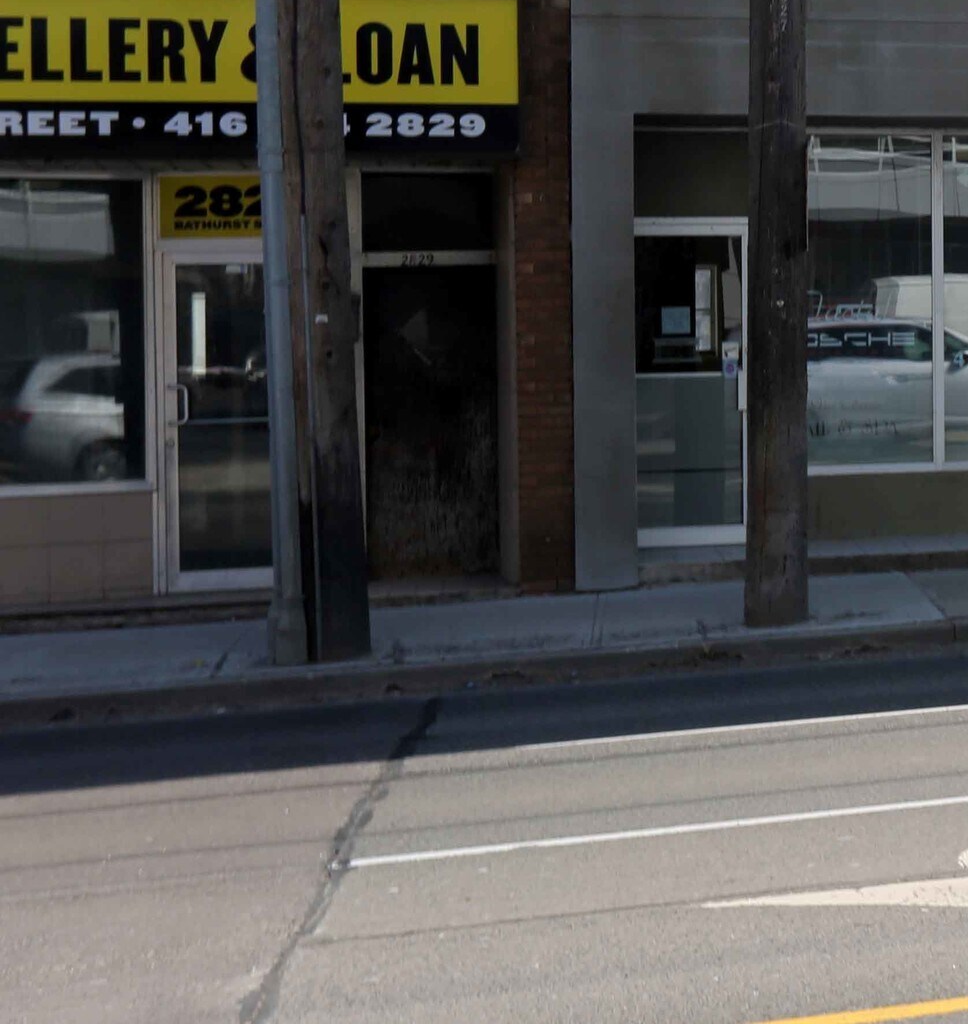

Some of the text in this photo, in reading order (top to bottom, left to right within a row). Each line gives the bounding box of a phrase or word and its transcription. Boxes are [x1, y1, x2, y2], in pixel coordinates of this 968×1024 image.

[342, 22, 480, 86] OAN
[164, 112, 248, 136] 416
[365, 114, 486, 138] 2829
[174, 220, 250, 230] BATHURST
